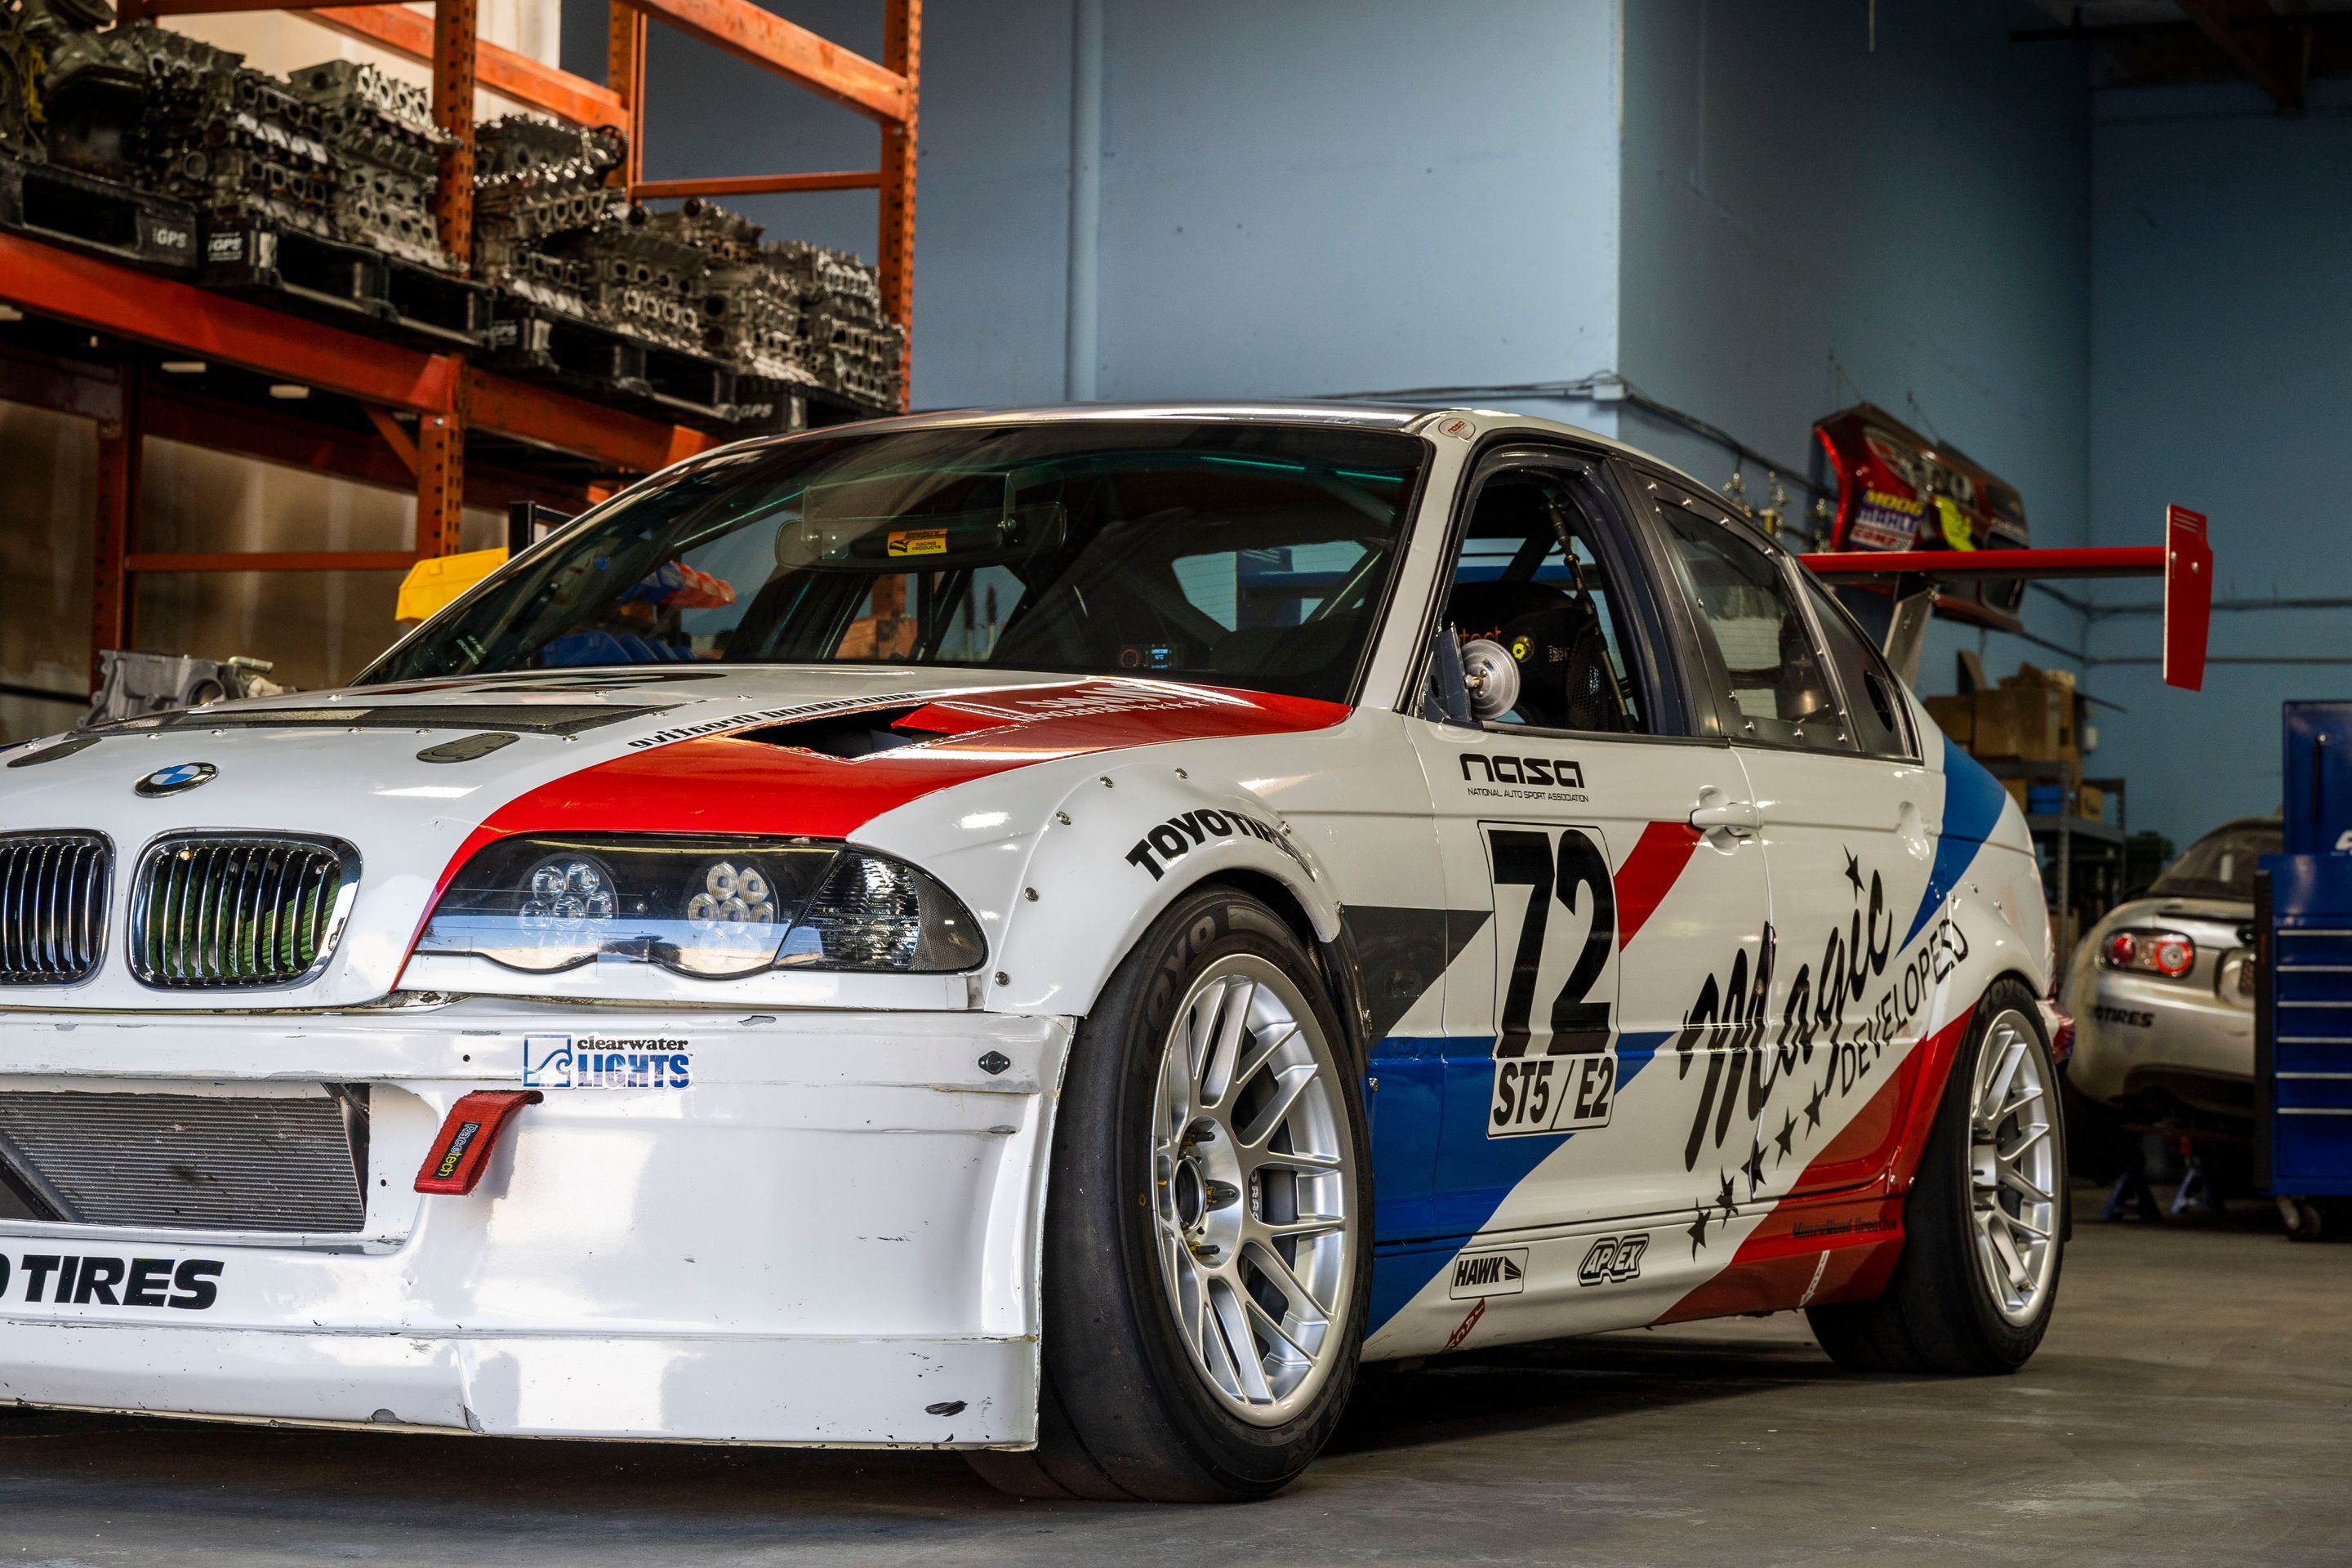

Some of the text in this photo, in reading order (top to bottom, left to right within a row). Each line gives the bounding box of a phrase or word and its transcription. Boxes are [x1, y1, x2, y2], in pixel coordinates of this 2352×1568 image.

[1864, 489, 1923, 517] MOOG
[1459, 754, 1584, 788] nasa
[1468, 787, 1589, 803] NATIONAL AUTO SPORT ASSOCIATION
[1125, 808, 1233, 883] TOYO
[1486, 828, 1616, 1059] 72
[1147, 915, 1217, 1032] OYO
[1676, 868, 1894, 1173] Magic
[1842, 919, 1969, 1098] DEVELOPED
[2105, 1007, 2155, 1028] TIRES
[577, 1036, 689, 1051] clearwater
[577, 1054, 690, 1089] LIGHTS
[438, 1123, 479, 1177] Racetech
[1454, 1256, 1504, 1288] HAWK
[1581, 1238, 1649, 1281] APEX
[20, 1254, 225, 1311] TIRES
